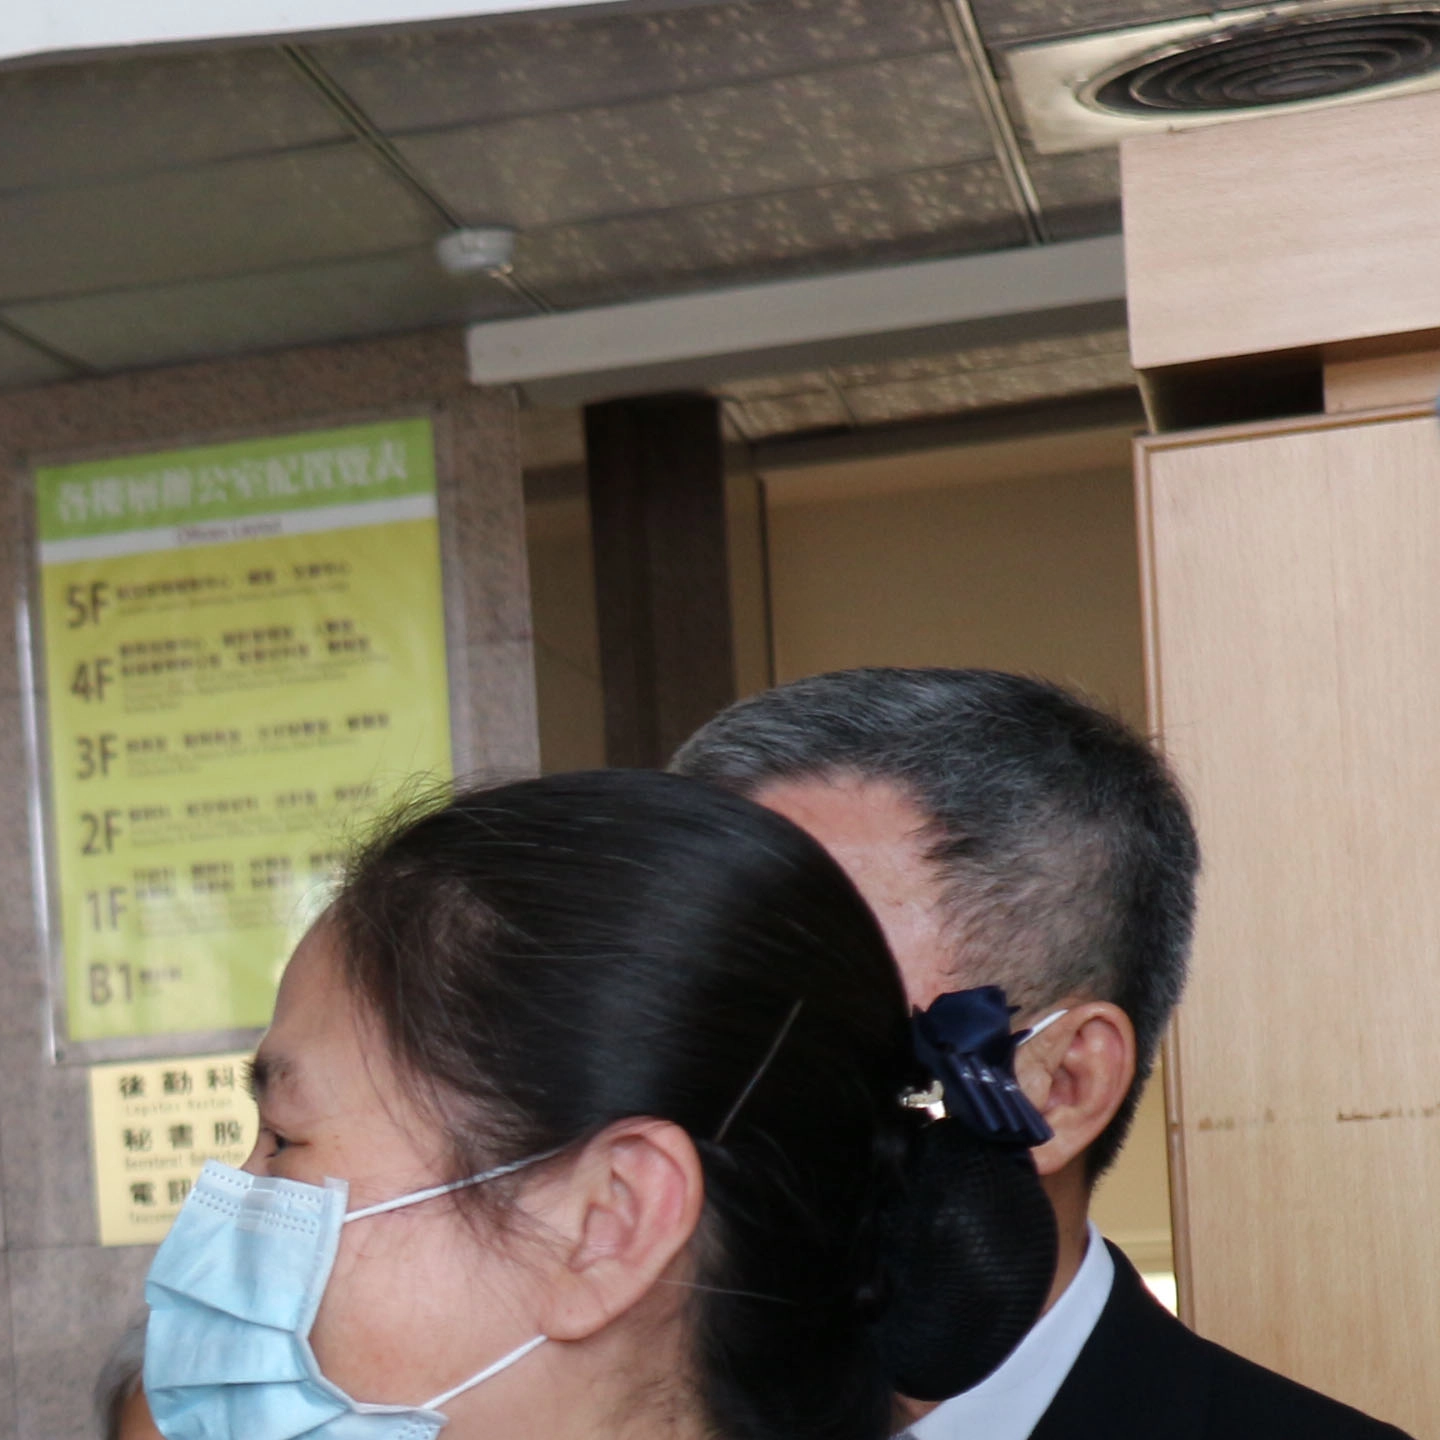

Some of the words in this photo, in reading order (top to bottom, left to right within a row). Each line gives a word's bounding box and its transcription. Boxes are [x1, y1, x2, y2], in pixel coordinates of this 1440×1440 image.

[65, 581, 110, 629] 5F
[71, 657, 114, 703] 4F
[75, 733, 118, 780] 3F
[80, 808, 123, 856] 2F
[85, 886, 128, 931] 1F
[88, 961, 133, 1006] B1
